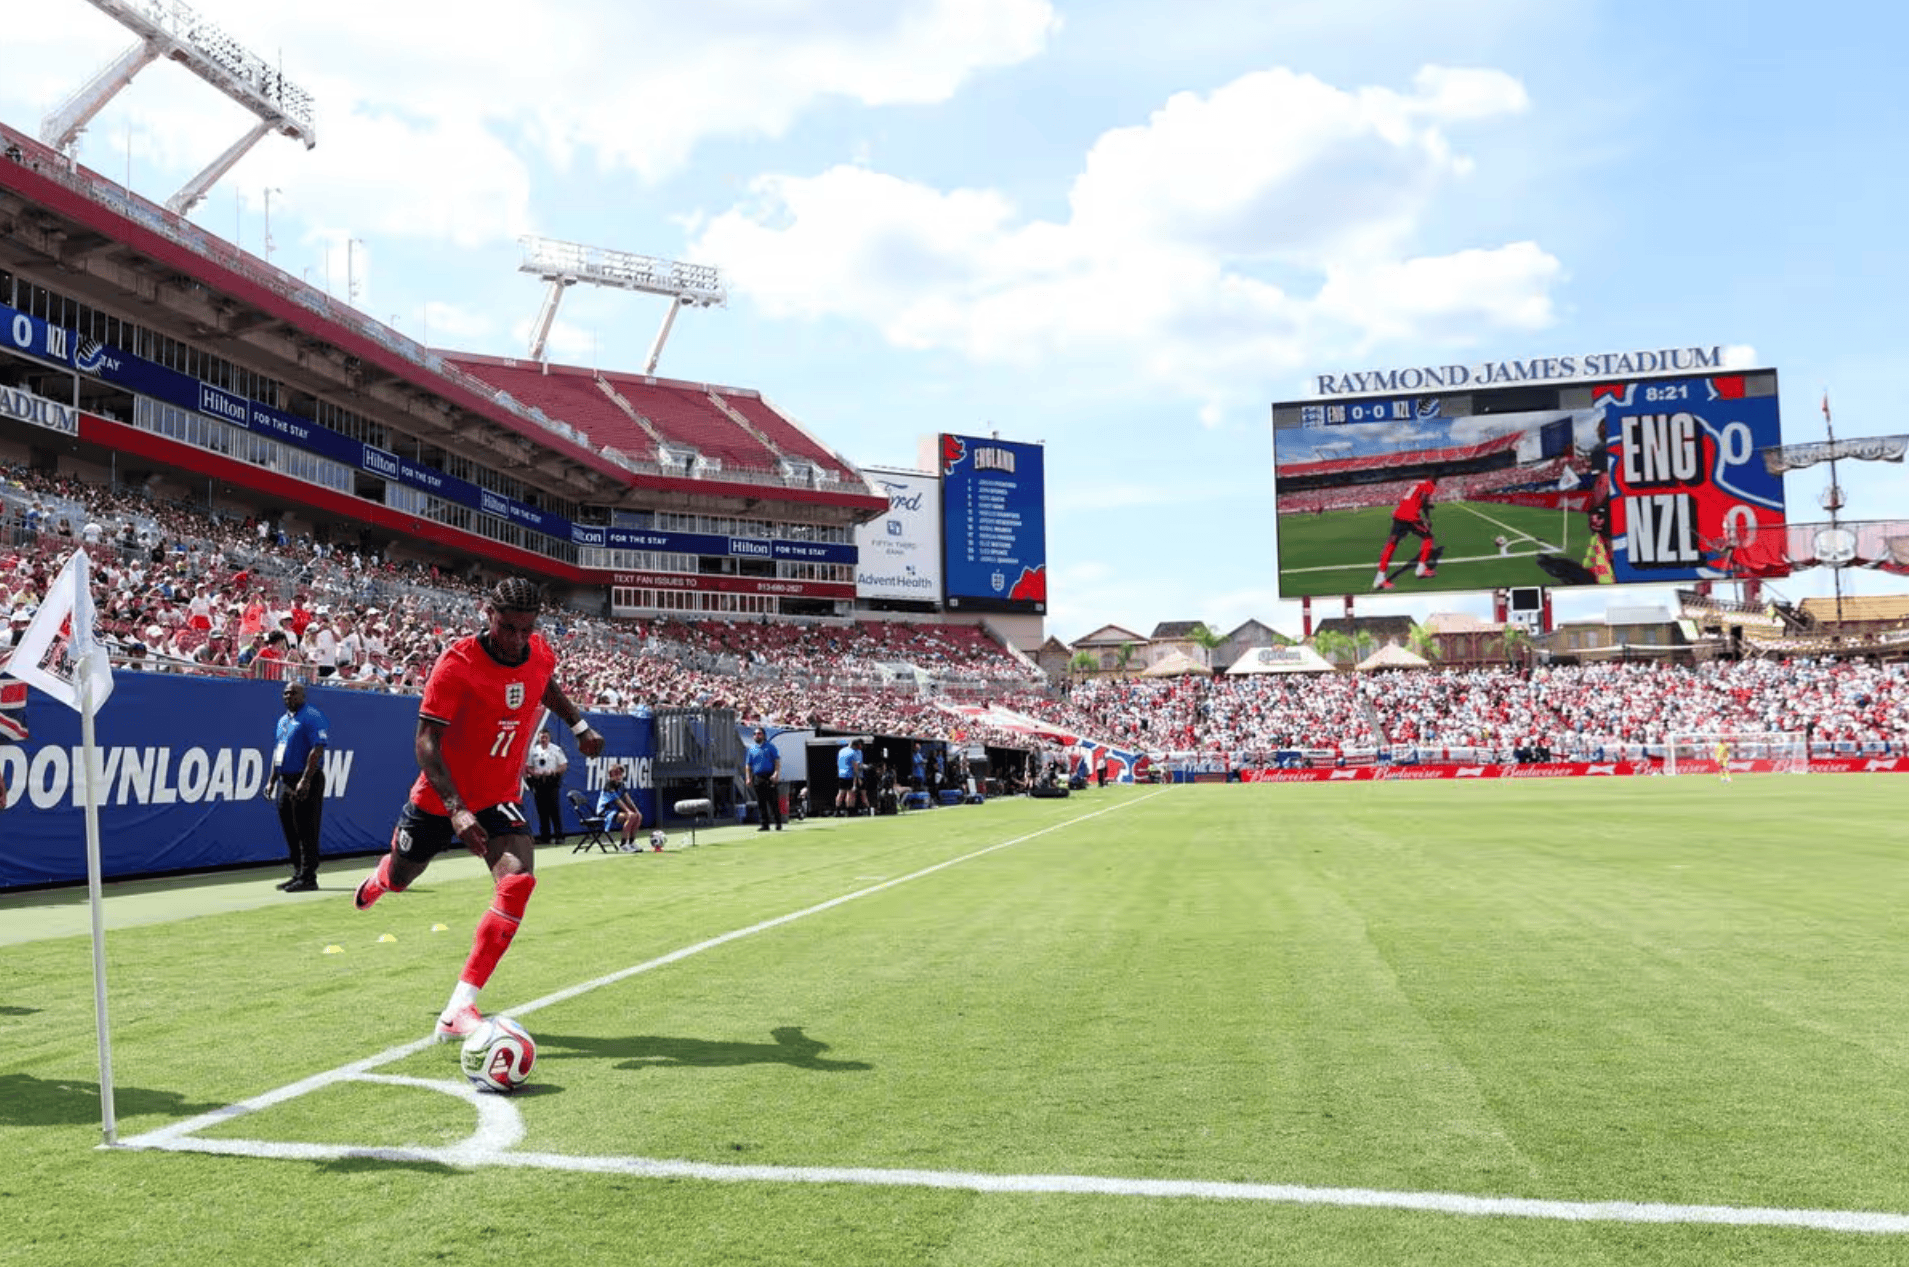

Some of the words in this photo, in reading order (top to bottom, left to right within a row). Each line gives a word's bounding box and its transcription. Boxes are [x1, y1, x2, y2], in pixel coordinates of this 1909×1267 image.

[12, 314, 32, 348] 0
[46, 322, 68, 360] NZL
[1317, 365, 1470, 395] RAYMOND
[1474, 357, 1576, 384] JAMES
[1583, 346, 1721, 377] STADIUM
[1645, 385, 1689, 401] 8:21
[203, 389, 246, 420] Hilton
[253, 411, 271, 426] FOR
[271, 418, 288, 432] THE
[289, 425, 309, 439] STAY
[1621, 412, 1698, 483] ENG
[1719, 421, 1753, 465] 0
[365, 450, 396, 475] Hilton
[401, 465, 414, 478] FOR
[414, 471, 427, 483] THE
[427, 476, 442, 487] STAY
[610, 534, 627, 542] FOR
[629, 535, 645, 544] THE
[647, 537, 667, 545] STAY
[1625, 493, 1700, 564] NZL
[732, 541, 768, 554] Hilton
[775, 546, 791, 554] FOR
[792, 547, 807, 555] THE
[808, 548, 826, 556] STAY
[614, 573, 634, 583] TEXT
[636, 575, 654, 585] FAN
[654, 577, 685, 586] ISSUES
[685, 578, 698, 587] TO
[490, 731, 516, 757] 11
[0, 744, 263, 810] DOWNLOAD
[1249, 767, 1318, 783] Budweiser
[1373, 764, 1444, 780] Budweiser
[1500, 761, 1573, 778] Budweiser
